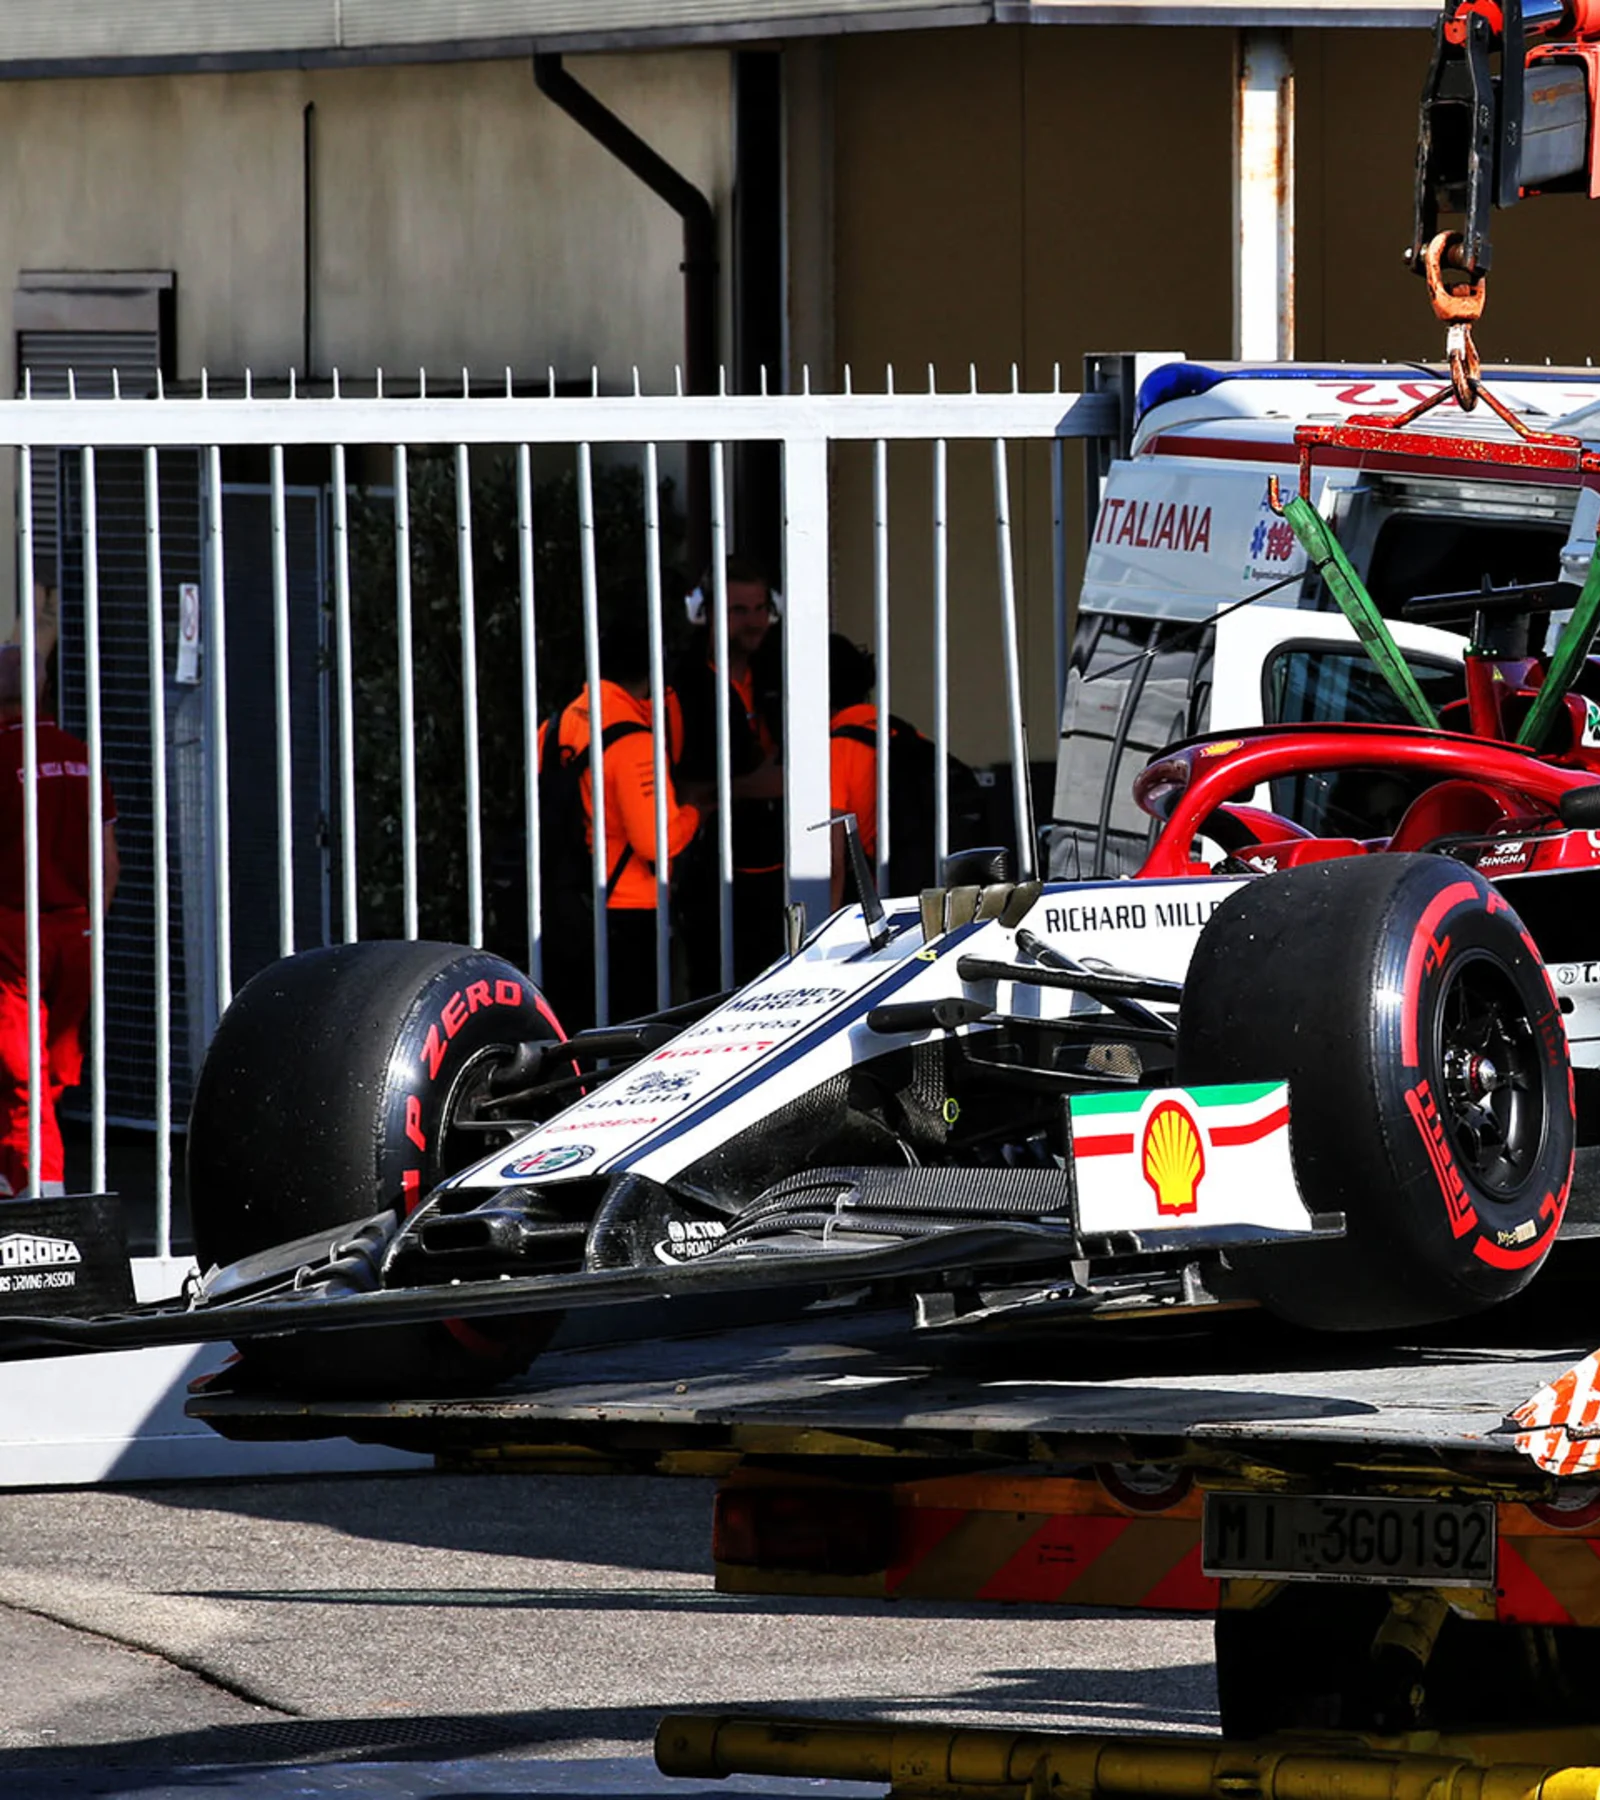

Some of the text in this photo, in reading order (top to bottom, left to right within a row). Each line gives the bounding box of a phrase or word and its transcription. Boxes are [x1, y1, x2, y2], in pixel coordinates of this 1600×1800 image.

[1095, 498, 1213, 553] ITALIANA
[1477, 853, 1527, 868] SINGHA
[1044, 904, 1147, 934] RICHARD
[419, 978, 522, 1081] ZERO
[1403, 1078, 1479, 1240] PIRELLI
[1216, 1504, 1276, 1561] MI
